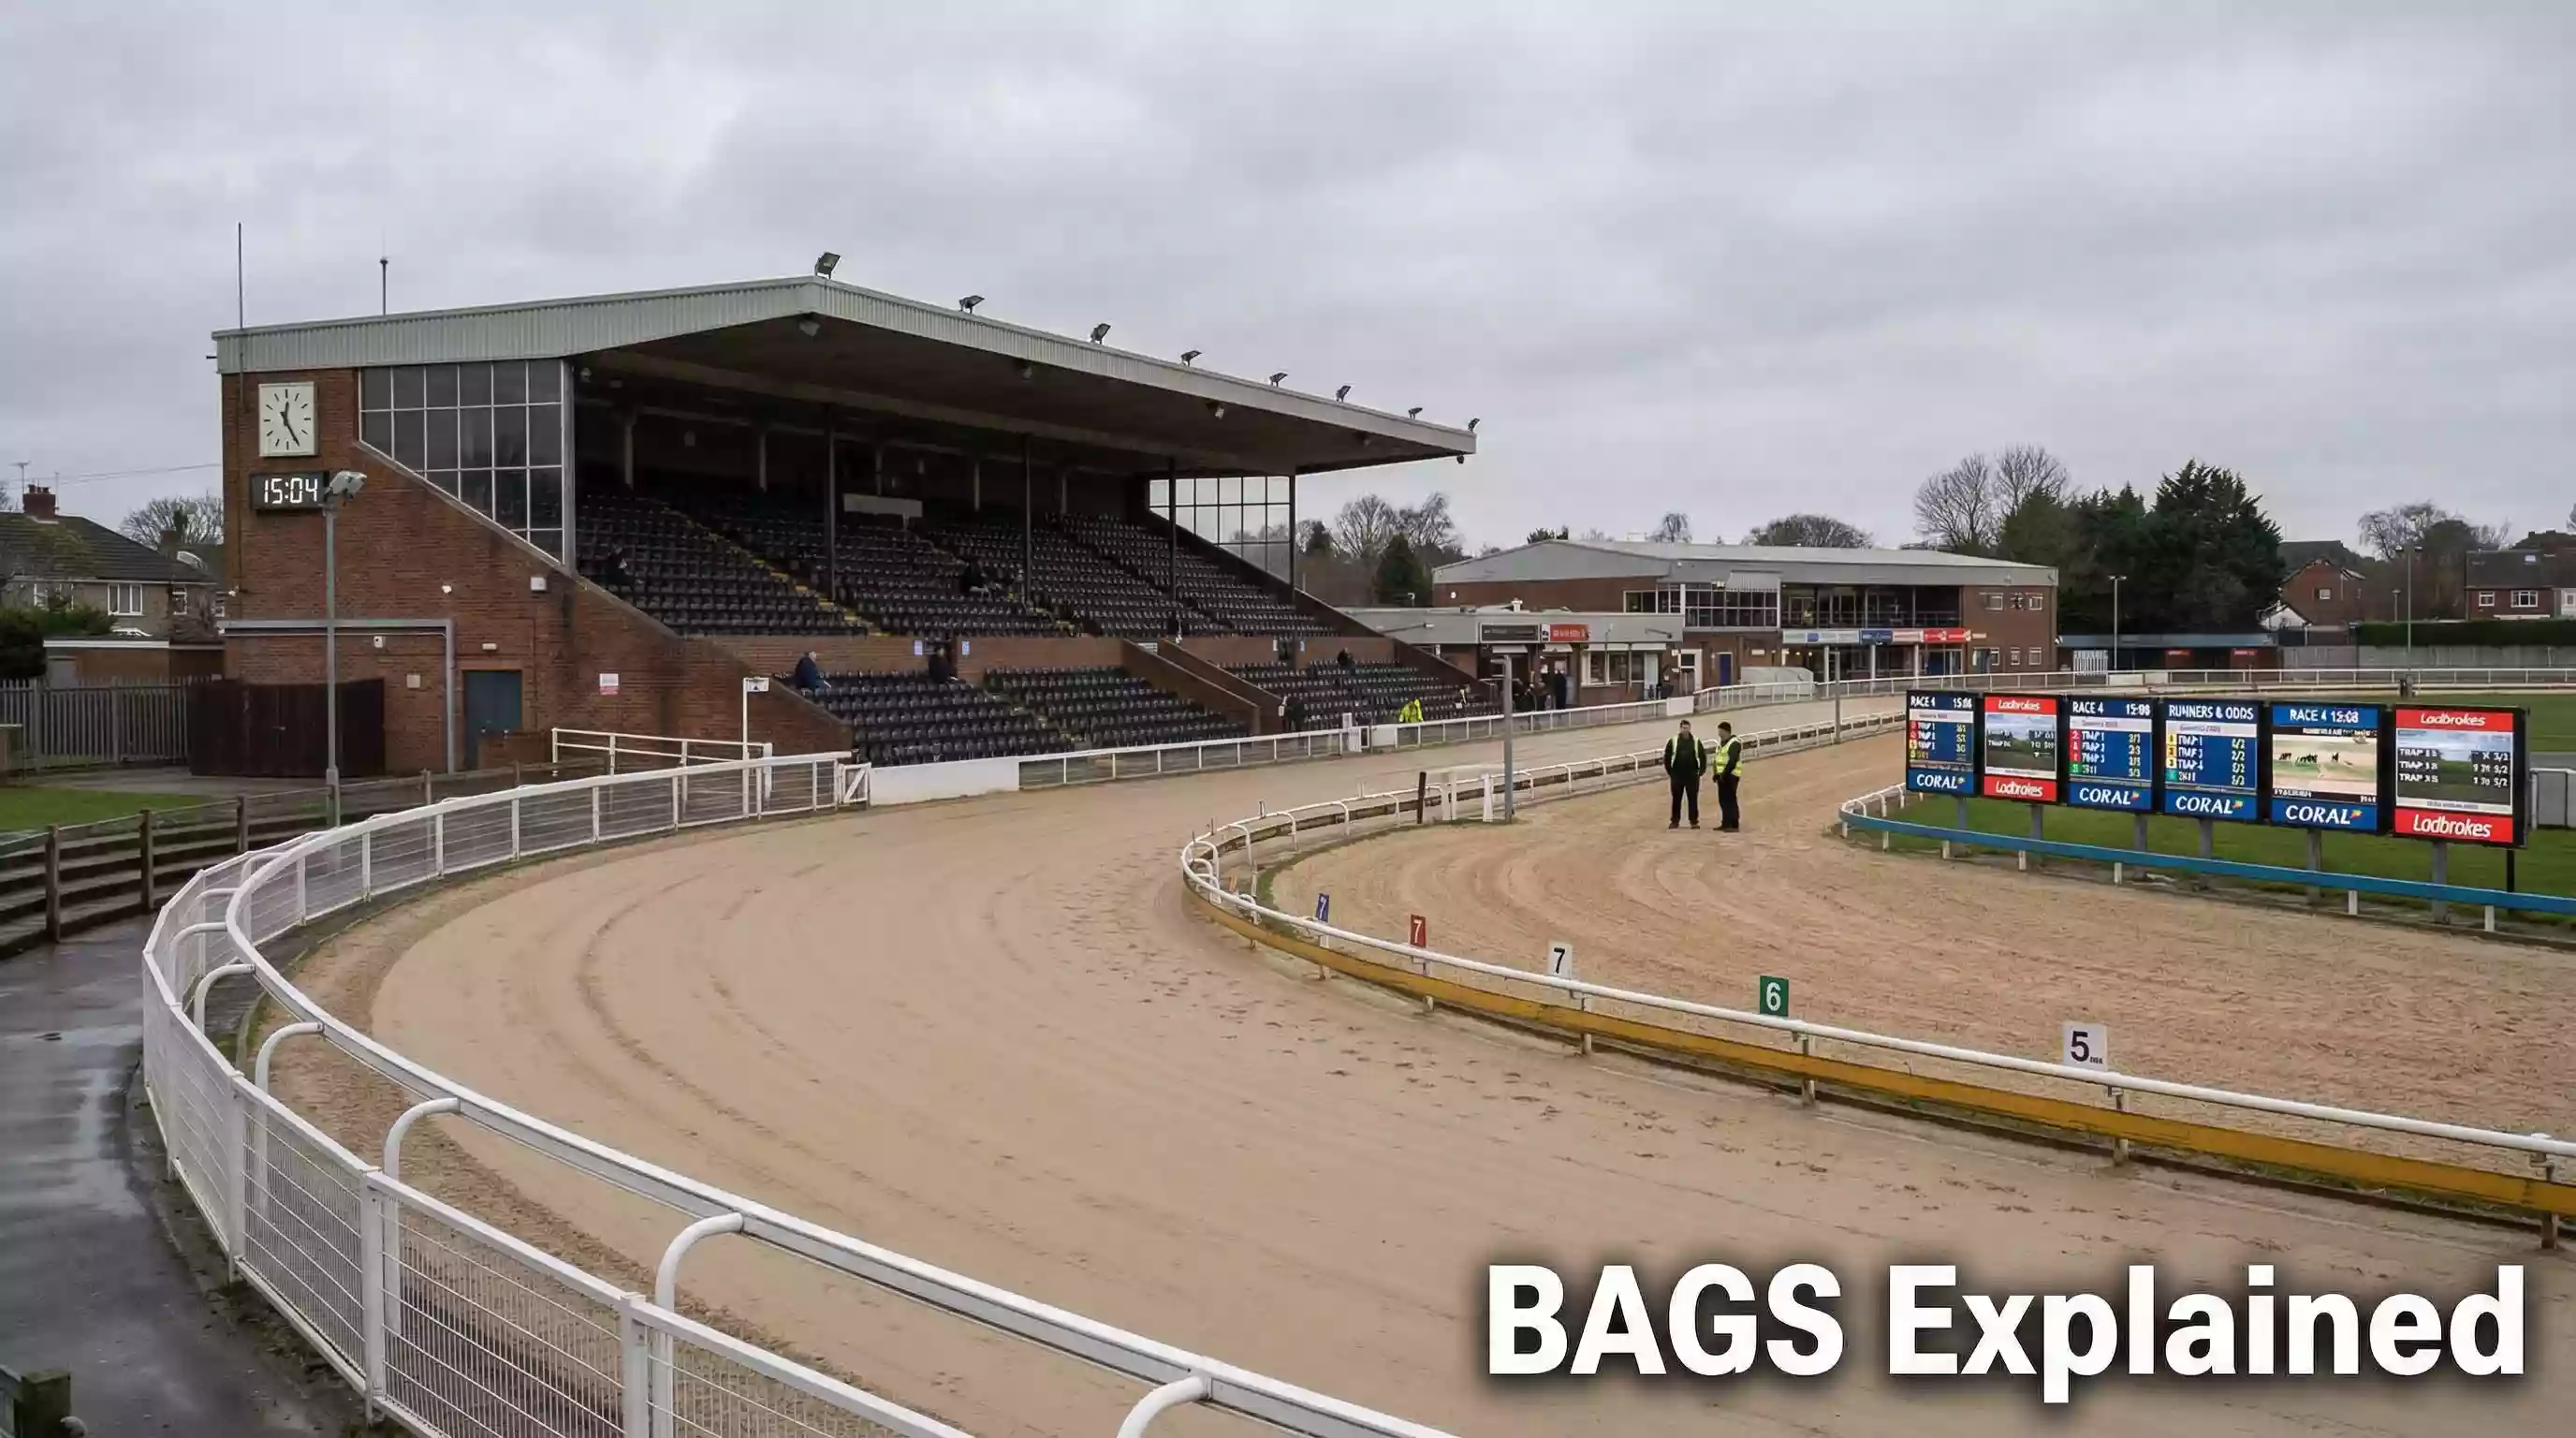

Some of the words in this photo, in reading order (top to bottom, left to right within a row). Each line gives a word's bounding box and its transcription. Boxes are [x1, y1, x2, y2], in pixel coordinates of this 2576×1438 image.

[264, 477, 318, 504] 15:04
[1998, 699, 2041, 711] Ladbrokes
[2072, 701, 2096, 713] RACE
[2098, 702, 2104, 714] 4
[2169, 704, 2214, 719] RUNNERS
[2225, 707, 2254, 720] ODDS
[2290, 709, 2319, 721] RACE
[2321, 710, 2327, 721] 4
[2421, 712, 2487, 726] Ladbrokes
[2399, 761, 2423, 770] TRAP
[1916, 774, 1958, 789] CORAL
[2399, 773, 2423, 782] TRAP
[1996, 779, 2043, 797] Ladbrokes
[2079, 787, 2130, 805] CORAL
[2175, 796, 2233, 814] CORAL
[2285, 804, 2351, 825] CORAL
[2413, 814, 2493, 837] Ladbrokes
[1413, 919, 1422, 944] 7
[1554, 947, 1565, 974] 7
[1766, 982, 1781, 1011] 6
[2071, 1031, 2089, 1062] 5
